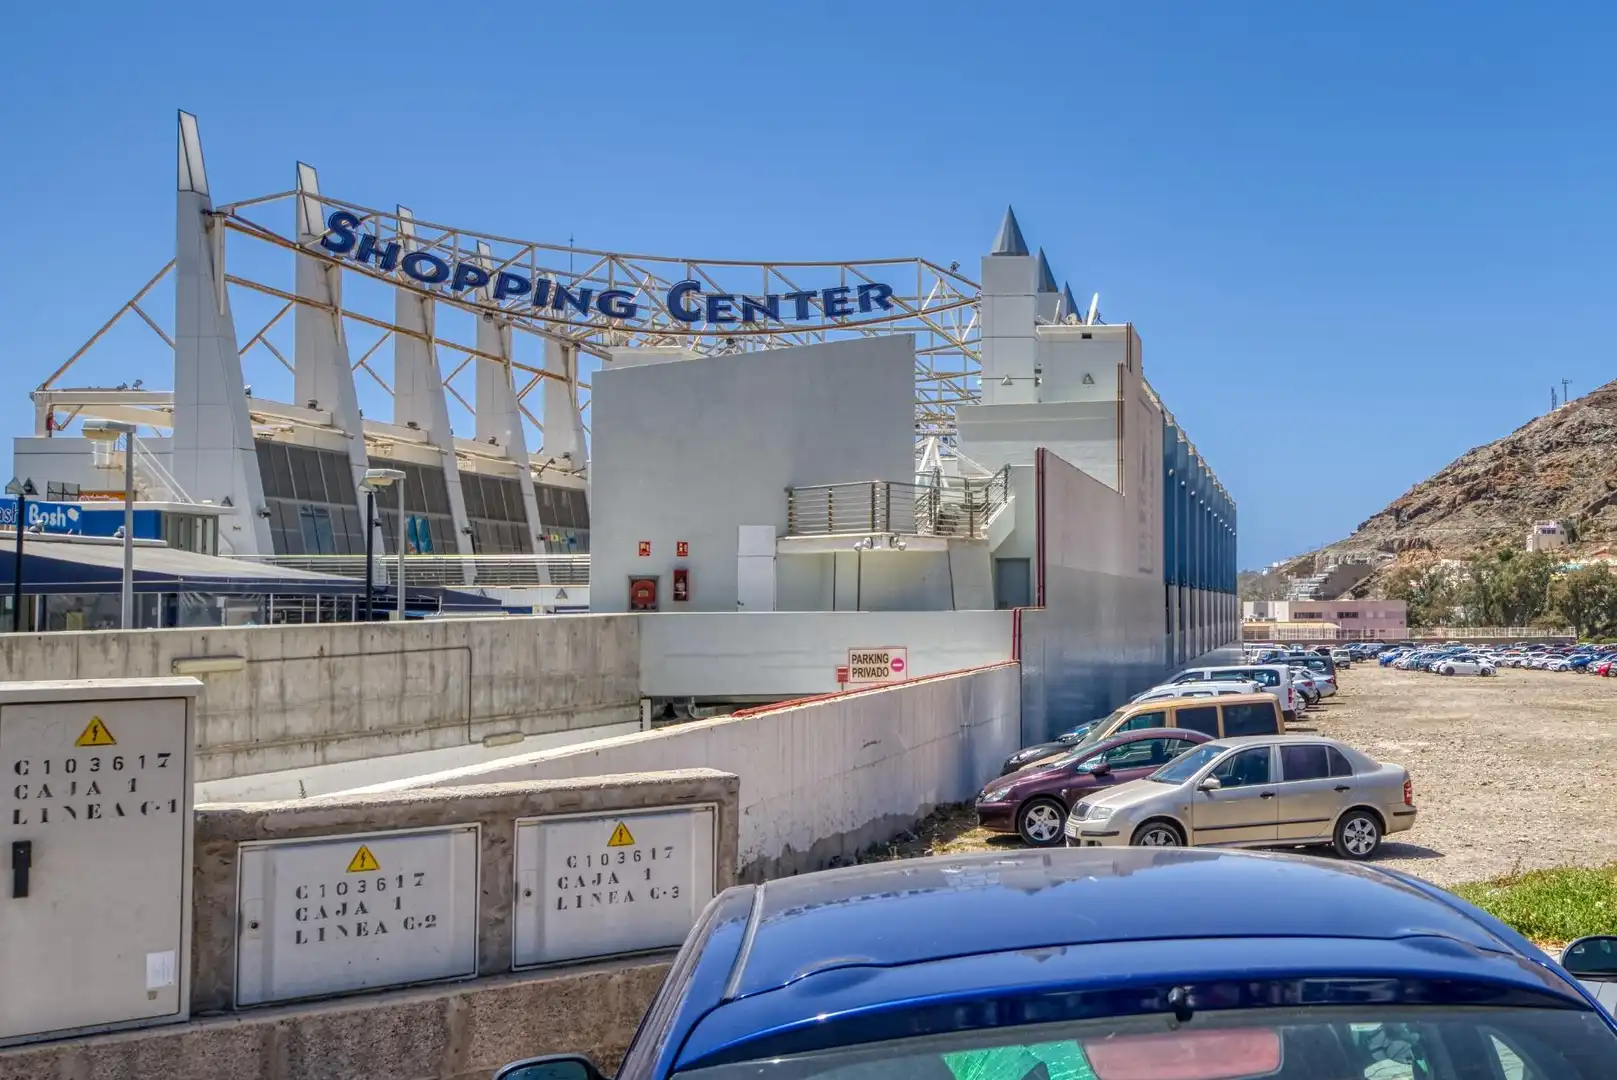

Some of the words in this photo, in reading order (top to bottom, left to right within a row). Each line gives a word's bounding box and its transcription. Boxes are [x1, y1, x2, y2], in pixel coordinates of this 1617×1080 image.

[320, 210, 637, 319] SHOPPING
[666, 279, 894, 324] CENTER
[851, 653, 889, 665] PARKING
[851, 666, 889, 678] PRIVADO
[13, 780, 102, 800] CAJA
[127, 777, 137, 793] 1
[12, 802, 126, 825] LINEA
[557, 872, 620, 890] CAJA
[643, 867, 652, 881] 1
[295, 900, 369, 922] CAJA
[393, 896, 402, 911] 1
[556, 890, 636, 911] LINEA
[295, 920, 389, 945] LINEA
